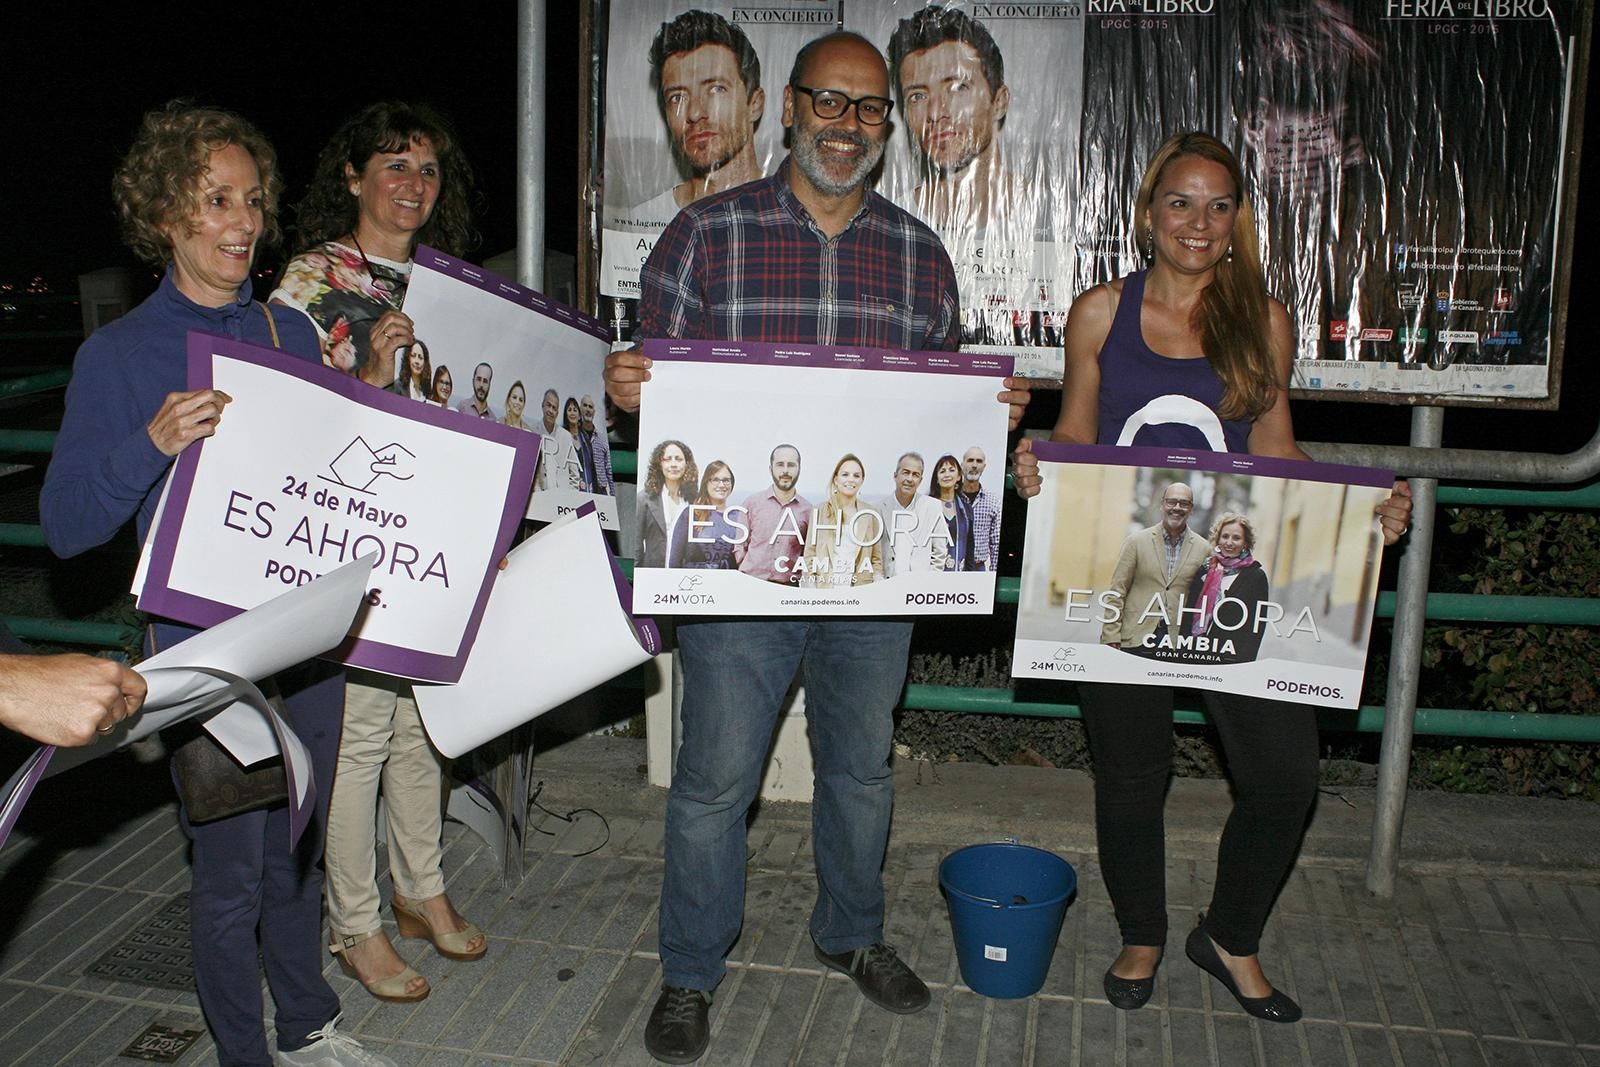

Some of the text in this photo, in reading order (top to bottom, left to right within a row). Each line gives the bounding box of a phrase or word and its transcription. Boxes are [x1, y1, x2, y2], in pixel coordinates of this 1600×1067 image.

[974, 6, 1081, 17] EN CONCIERTO
[1143, 0, 1214, 14] LIBRO
[1386, 0, 1455, 17] FERIA
[1473, 0, 1549, 17] LIBRO
[732, 10, 833, 22] EN CONCIERTO
[1100, 20, 1131, 29] LPGC
[1140, 20, 1168, 29] 2015
[1428, 24, 1460, 34] LPGC
[1469, 24, 1500, 34] 2015
[282, 475, 408, 529] 24 de Mayo
[687, 504, 956, 548] ES AHORA
[223, 489, 450, 589] ES AHORA
[774, 555, 875, 574] CAMBIA
[265, 559, 388, 609] PODS.
[780, 599, 860, 607] canarias.podemos.info
[905, 593, 979, 606] PODEMOS.
[1063, 588, 1323, 643] ES AHORA
[1142, 633, 1237, 656] CAMBIA
[1155, 650, 1222, 663] GRAN CANARIA
[1146, 670, 1224, 683] canarias.podemos.info
[1266, 678, 1345, 700] PODEMOS.
